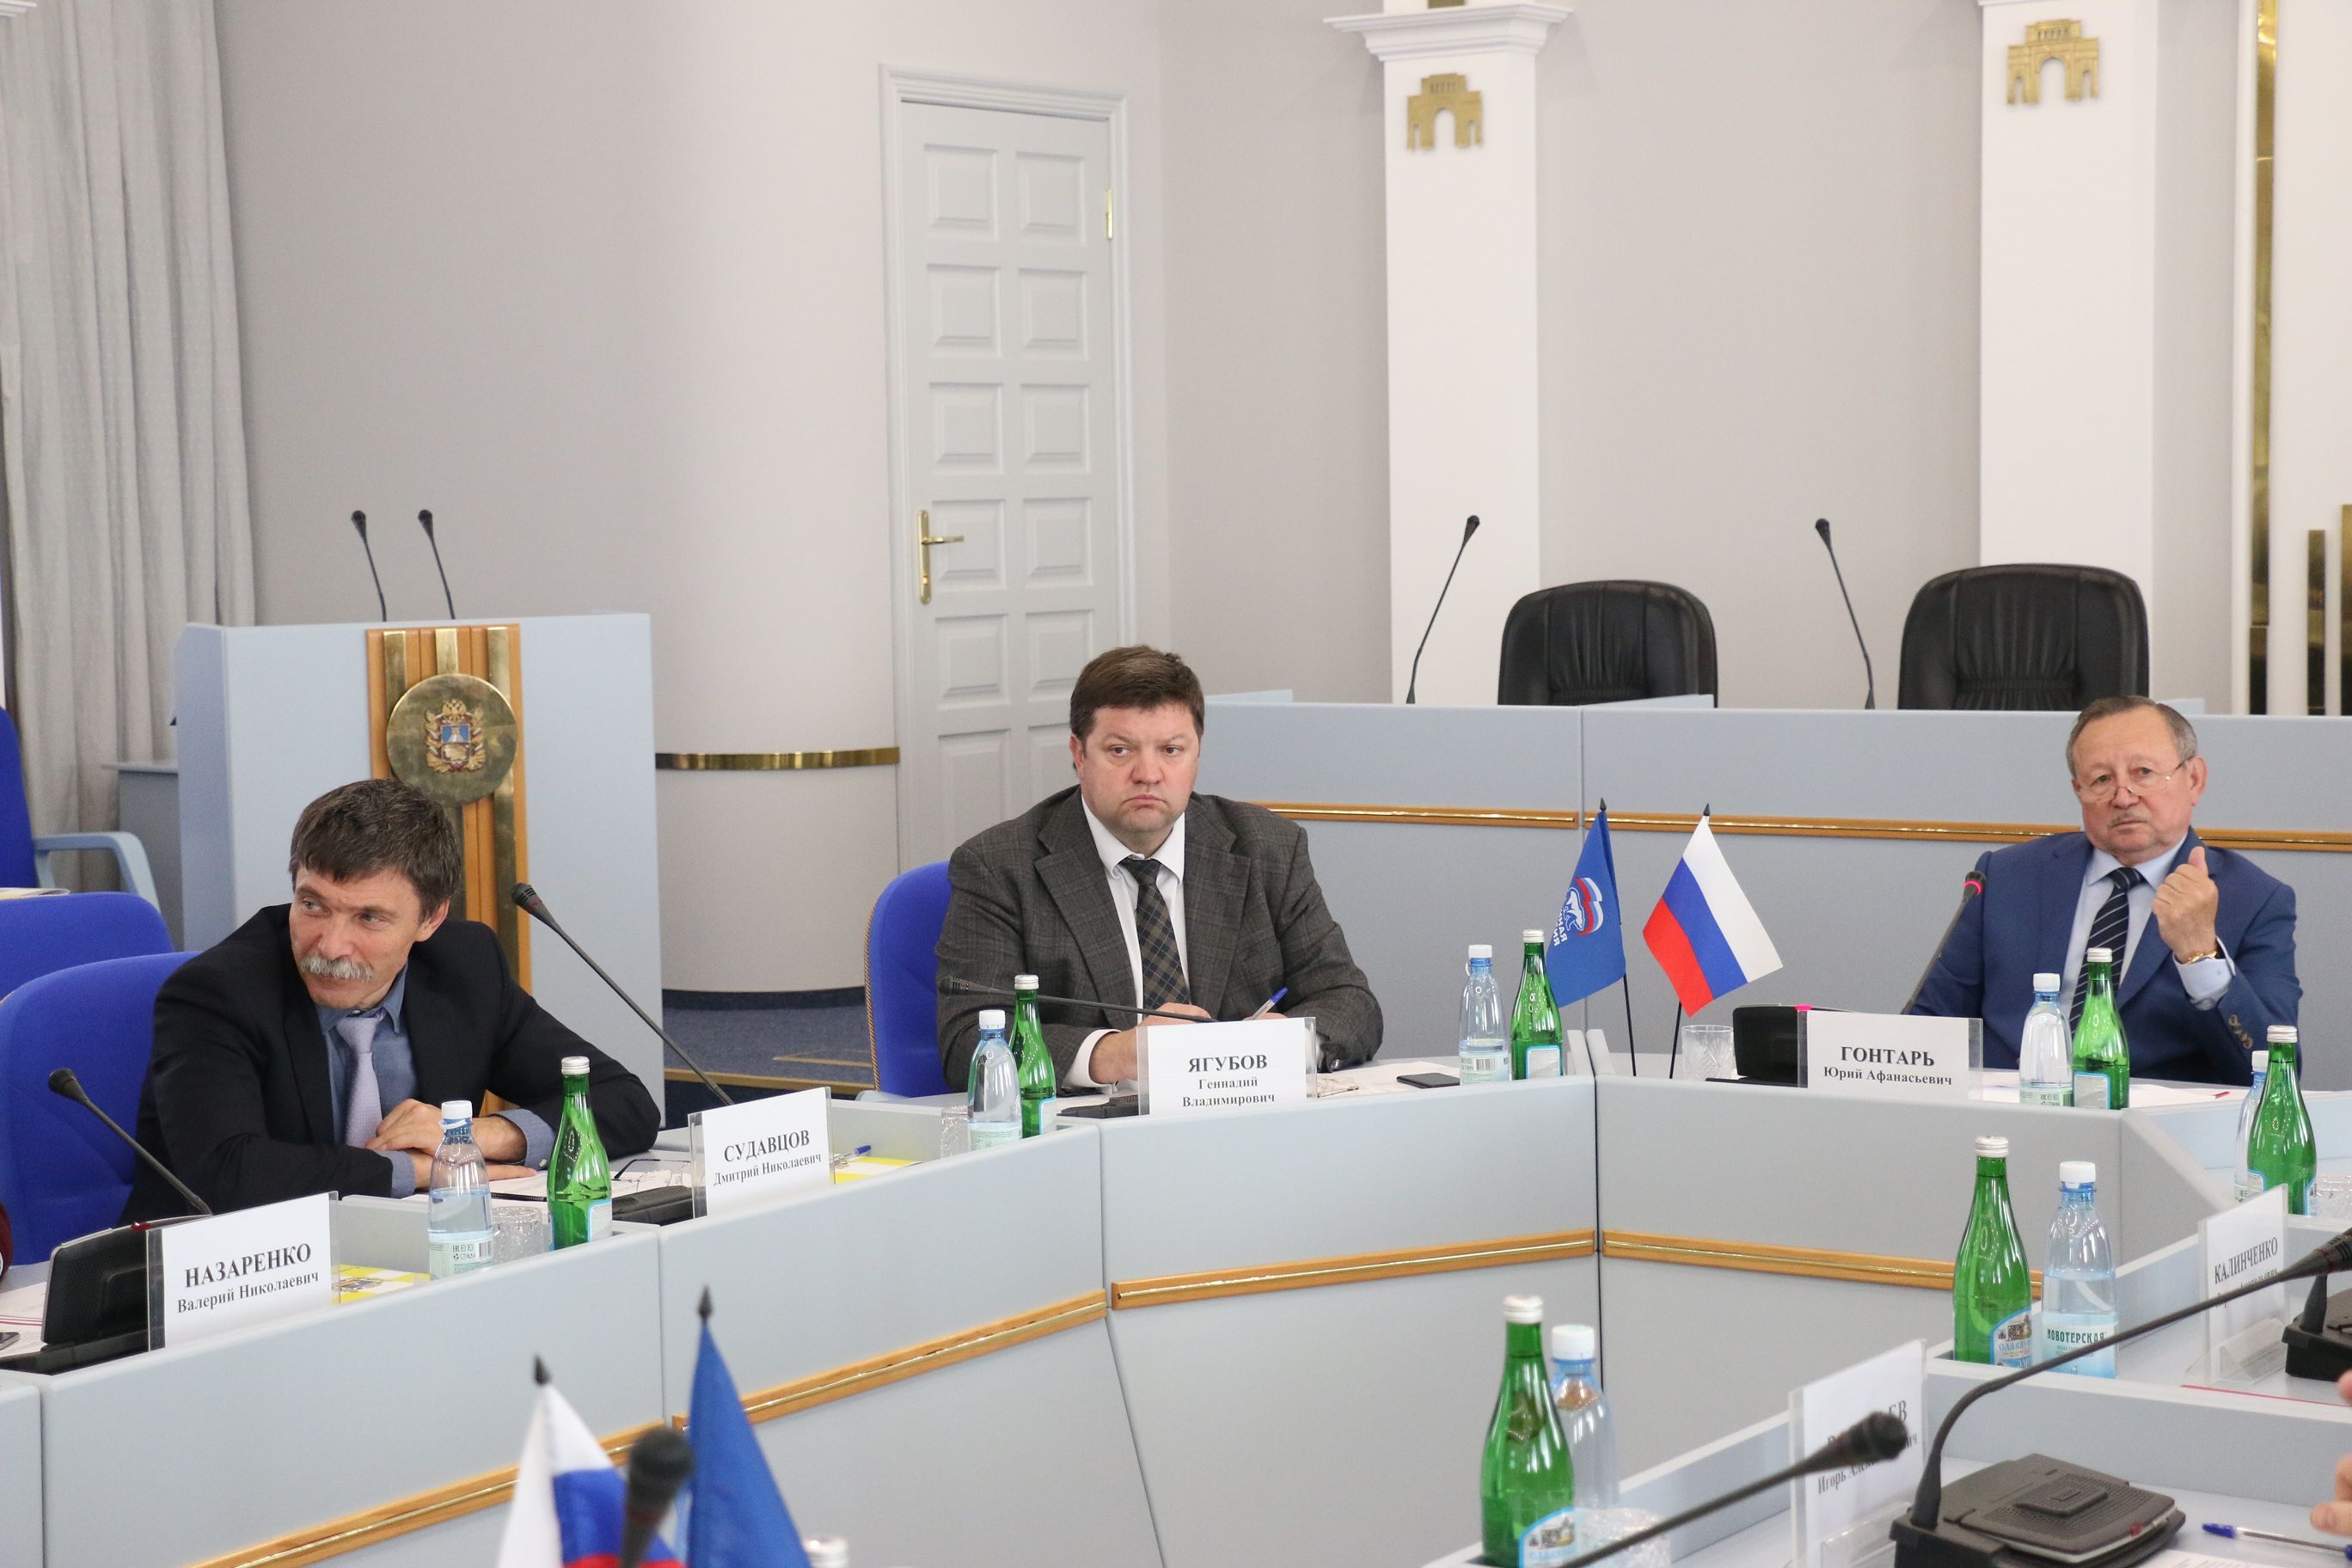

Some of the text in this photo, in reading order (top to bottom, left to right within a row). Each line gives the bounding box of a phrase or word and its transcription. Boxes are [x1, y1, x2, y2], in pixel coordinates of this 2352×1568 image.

[1188, 1054, 1267, 1073] ЯГУБОВ
[1841, 1046, 1935, 1066] ГОНТАРЬ
[1198, 1076, 1258, 1089] Геннадий
[1823, 1066, 1952, 1085] Юрий Афанасьевич
[1182, 1094, 1275, 1107] Владимирович
[724, 1130, 810, 1162] СУДАВЦОВ
[714, 1154, 822, 1187] Дмитрий Николаевич
[185, 1243, 311, 1288] НАЗАРЕНКО
[2214, 1237, 2278, 1284] КАЛИНЧЕНКО
[177, 1271, 319, 1314] Валерий Николаевич
[2047, 1328, 2104, 1344] НОВОТЕРСКАЯ
[1817, 1471, 1846, 1494] Игорь
